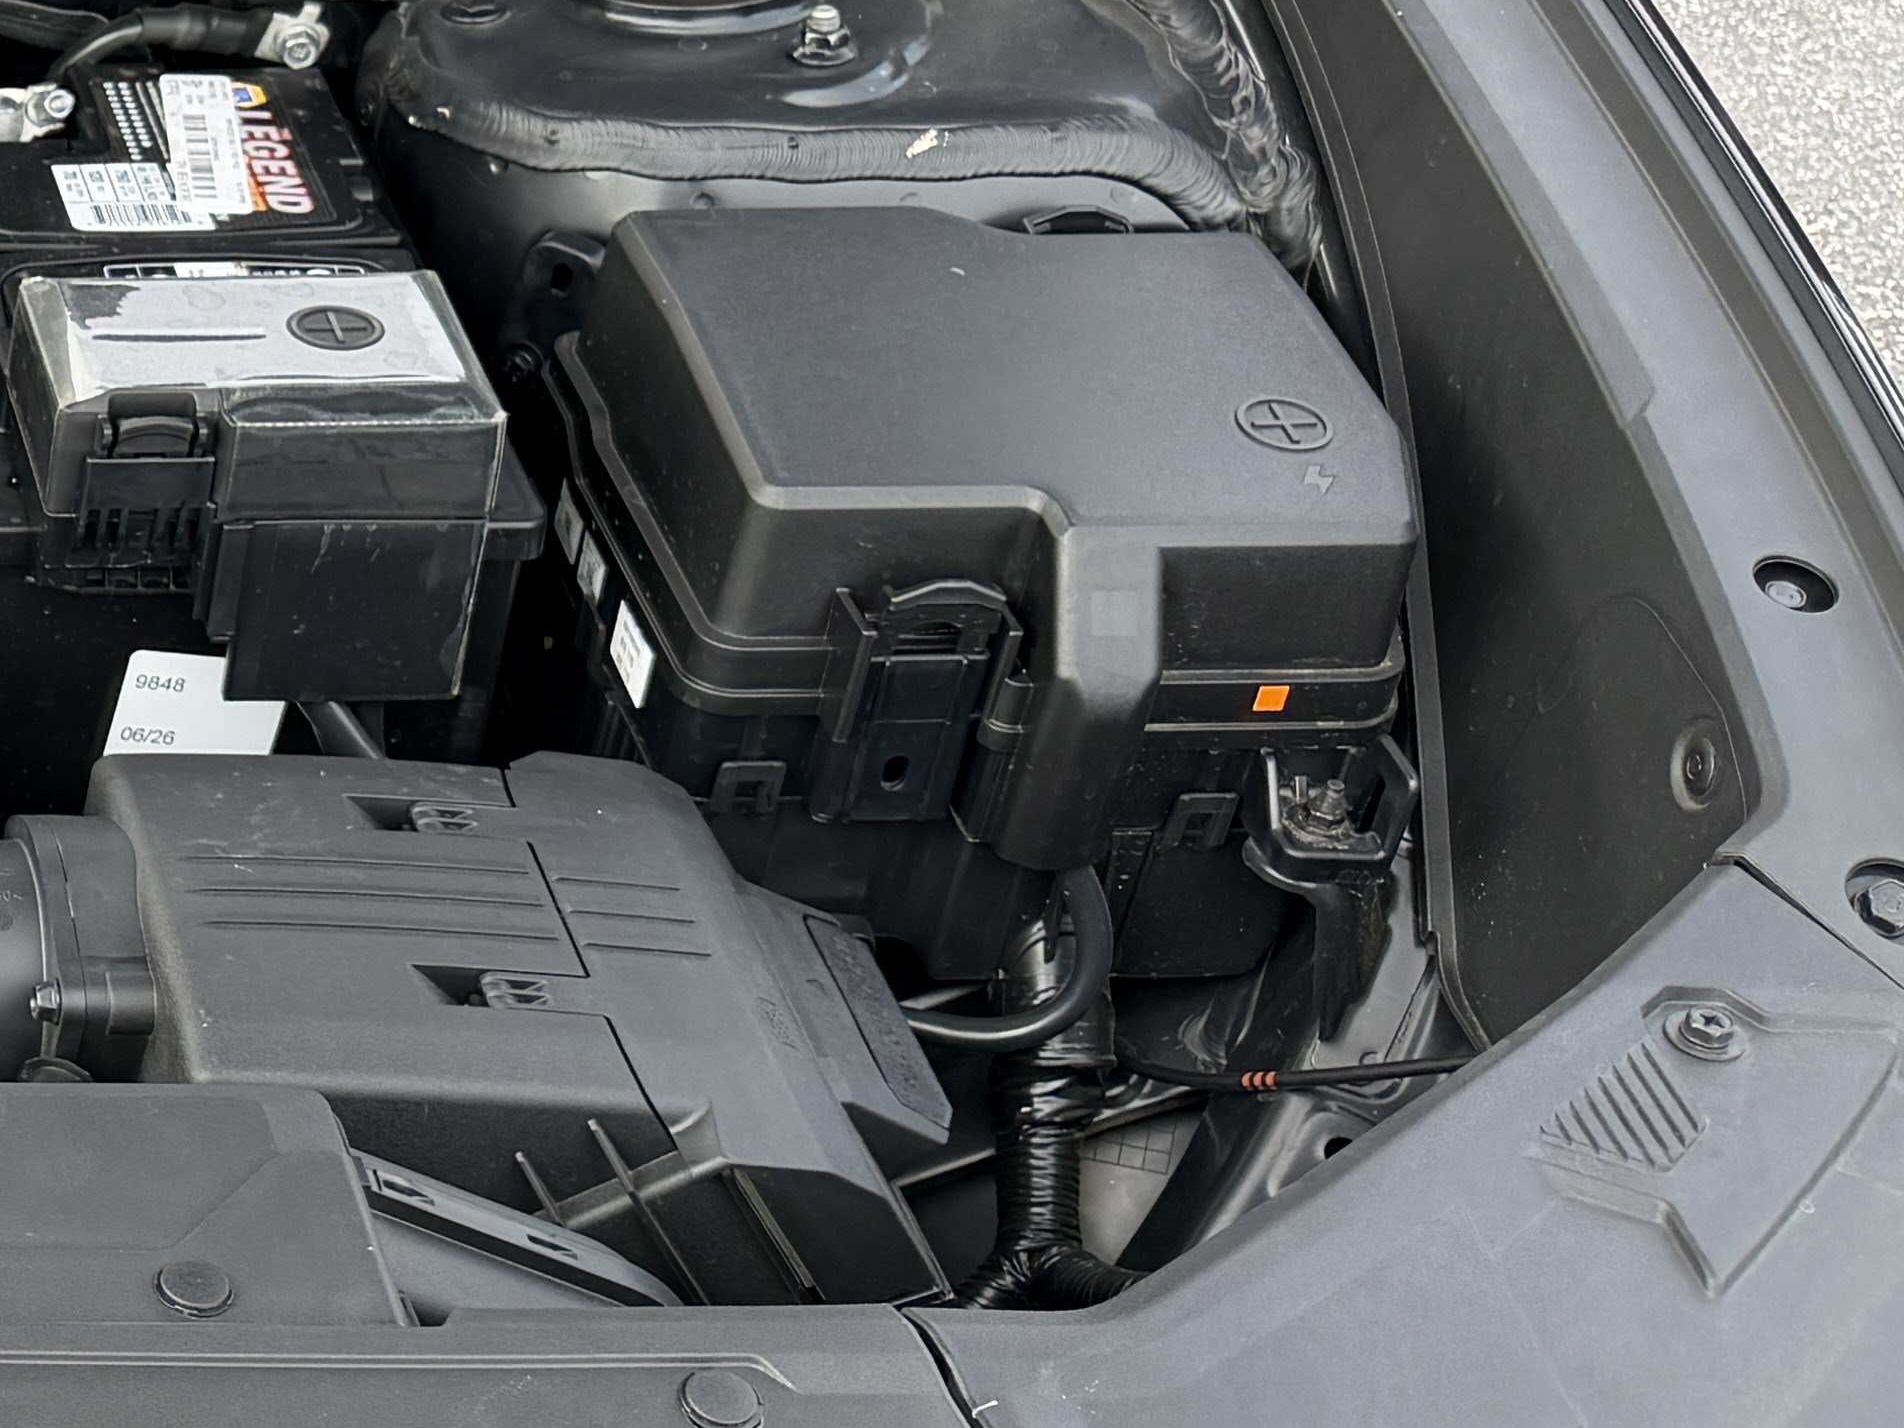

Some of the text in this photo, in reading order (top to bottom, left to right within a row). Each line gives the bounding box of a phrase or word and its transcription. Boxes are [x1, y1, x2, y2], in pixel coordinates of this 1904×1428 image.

[242, 110, 316, 215] LEGEND
[134, 674, 186, 693] 9848
[120, 726, 176, 746] 06/26
